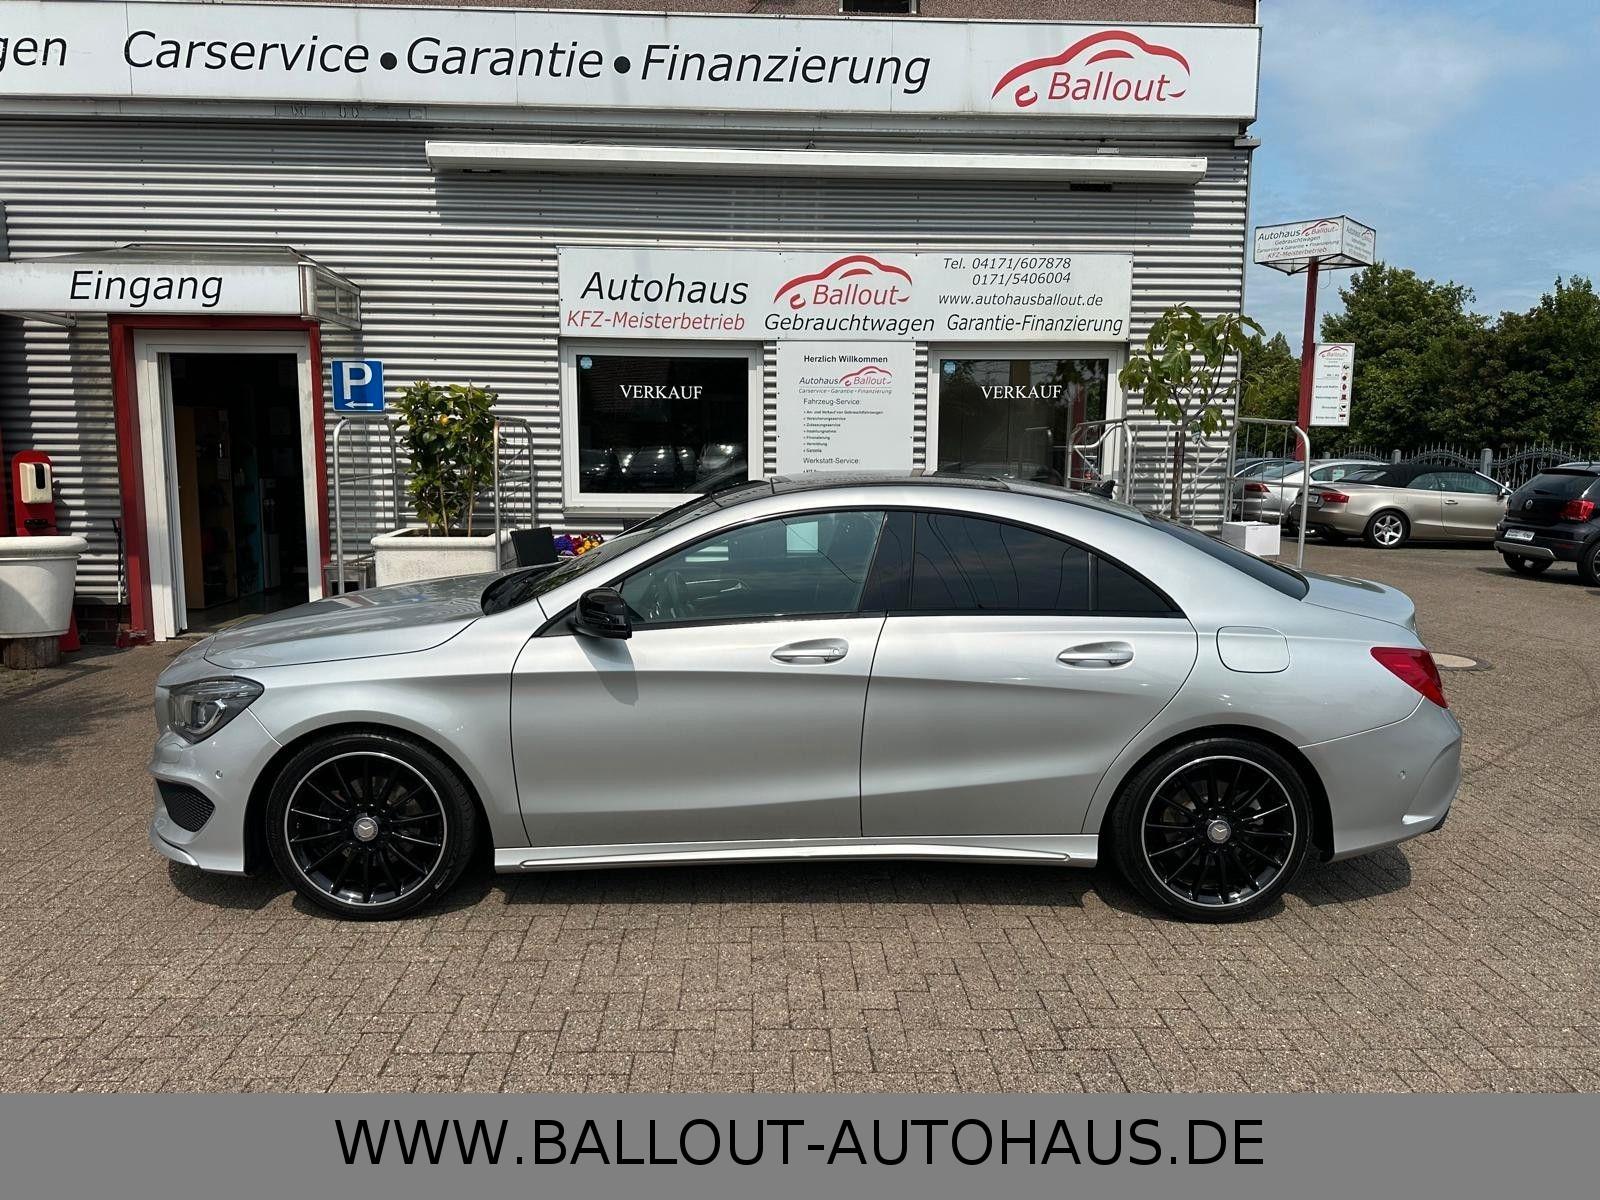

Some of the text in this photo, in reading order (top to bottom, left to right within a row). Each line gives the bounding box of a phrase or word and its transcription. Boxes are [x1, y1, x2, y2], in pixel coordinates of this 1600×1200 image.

[124, 31, 369, 73] Carservice
[407, 37, 603, 79] Garantie
[642, 45, 931, 94] Finanzierung
[1048, 70, 1168, 102] Ballout
[1257, 229, 1301, 241] Autohaus
[1275, 236, 1321, 246] Gebrauchtwagen
[1267, 247, 1328, 259] KFZ-Meisterbetrieb
[943, 257, 1071, 271] Tel. 04171/607878
[972, 272, 1071, 286] 0171/5406004
[69, 270, 224, 308] Eingang
[580, 272, 749, 305] Autohaus
[813, 283, 899, 306] Ballout
[938, 293, 1103, 307] www.autohausballout.de
[567, 311, 745, 331] KFZ-Meisterbetrieb
[765, 314, 935, 336] Gebrauchtwagen
[947, 314, 1123, 336] Garantie-Finanzierung
[803, 355, 888, 363] Herzlich Willkommen
[343, 362, 373, 400] P
[799, 376, 886, 385] Autohaus Ballout
[619, 385, 703, 400] VERKAUF
[981, 385, 1062, 399] VERKAUF
